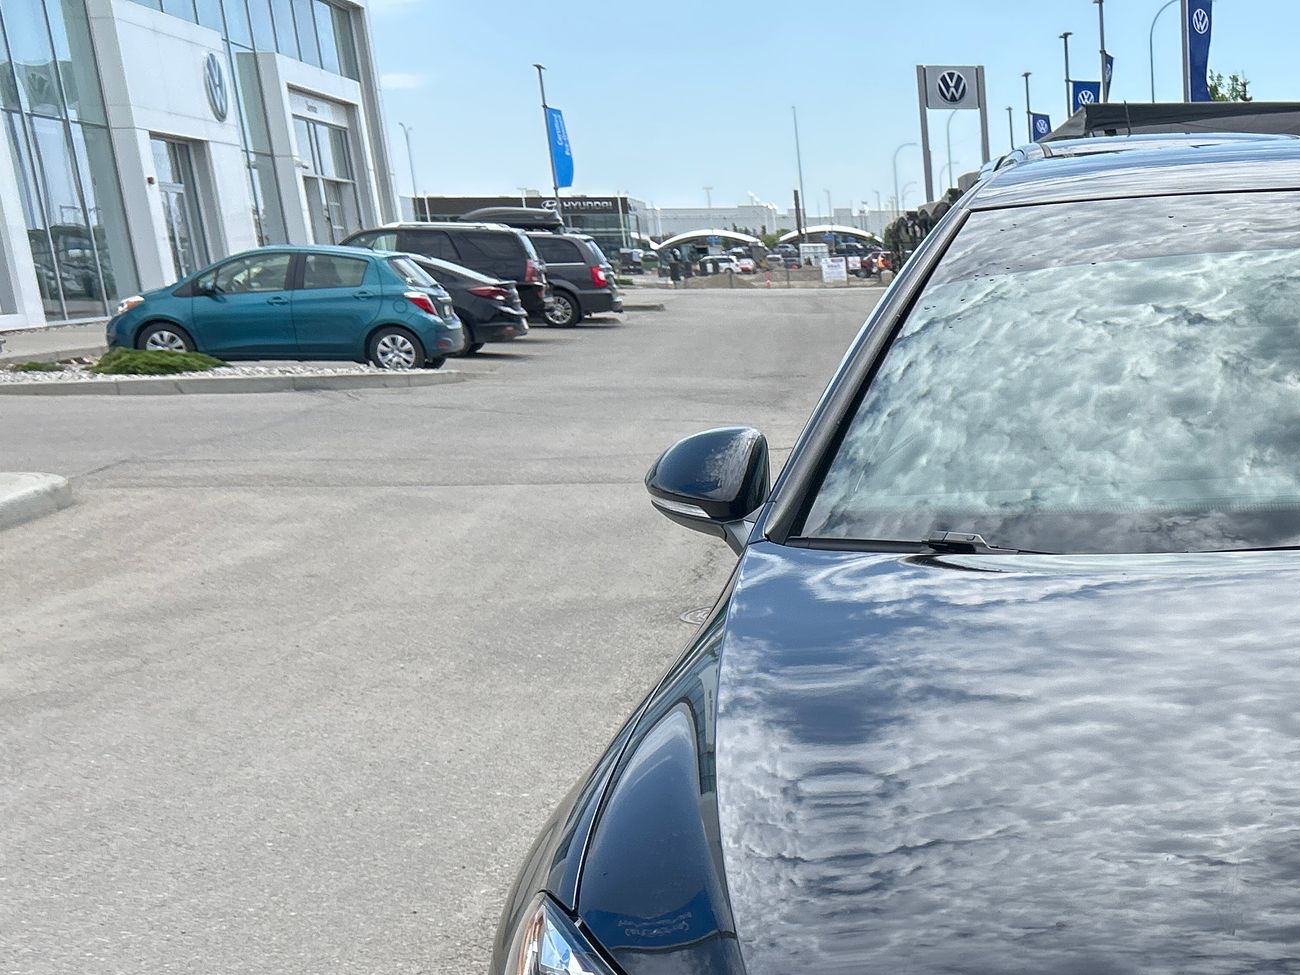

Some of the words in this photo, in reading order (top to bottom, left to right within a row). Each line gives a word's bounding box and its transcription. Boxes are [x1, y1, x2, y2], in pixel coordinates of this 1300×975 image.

[1193, 8, 1209, 34] VW
[937, 70, 968, 103] VW
[563, 201, 613, 210] HYUNDAI
